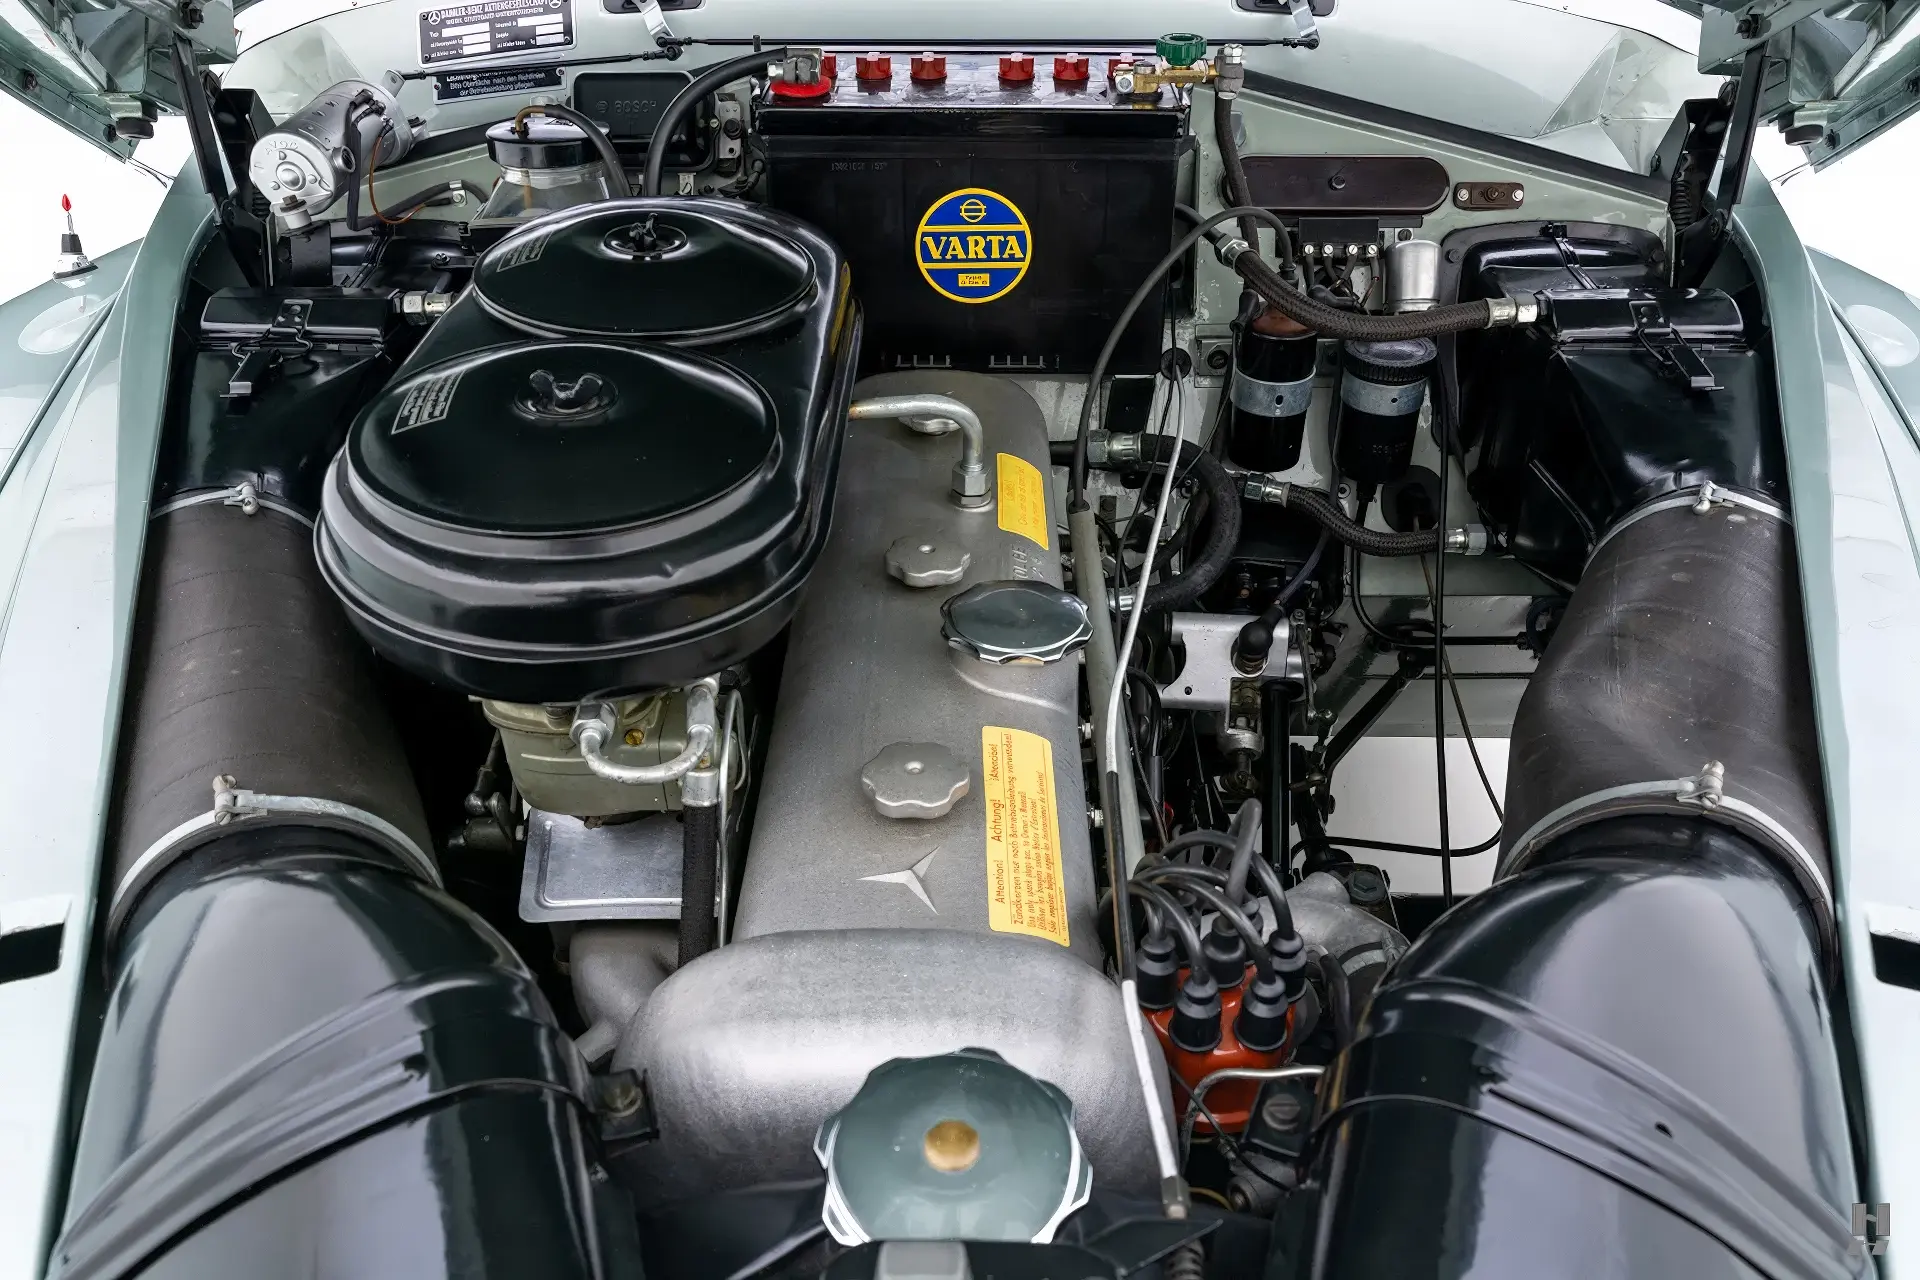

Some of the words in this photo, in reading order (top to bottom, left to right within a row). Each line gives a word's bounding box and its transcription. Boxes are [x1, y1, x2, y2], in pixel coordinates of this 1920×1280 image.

[922, 235, 1024, 260] VARTA
[990, 799, 1004, 843] Achtung!
[993, 860, 1005, 905] Attention!
